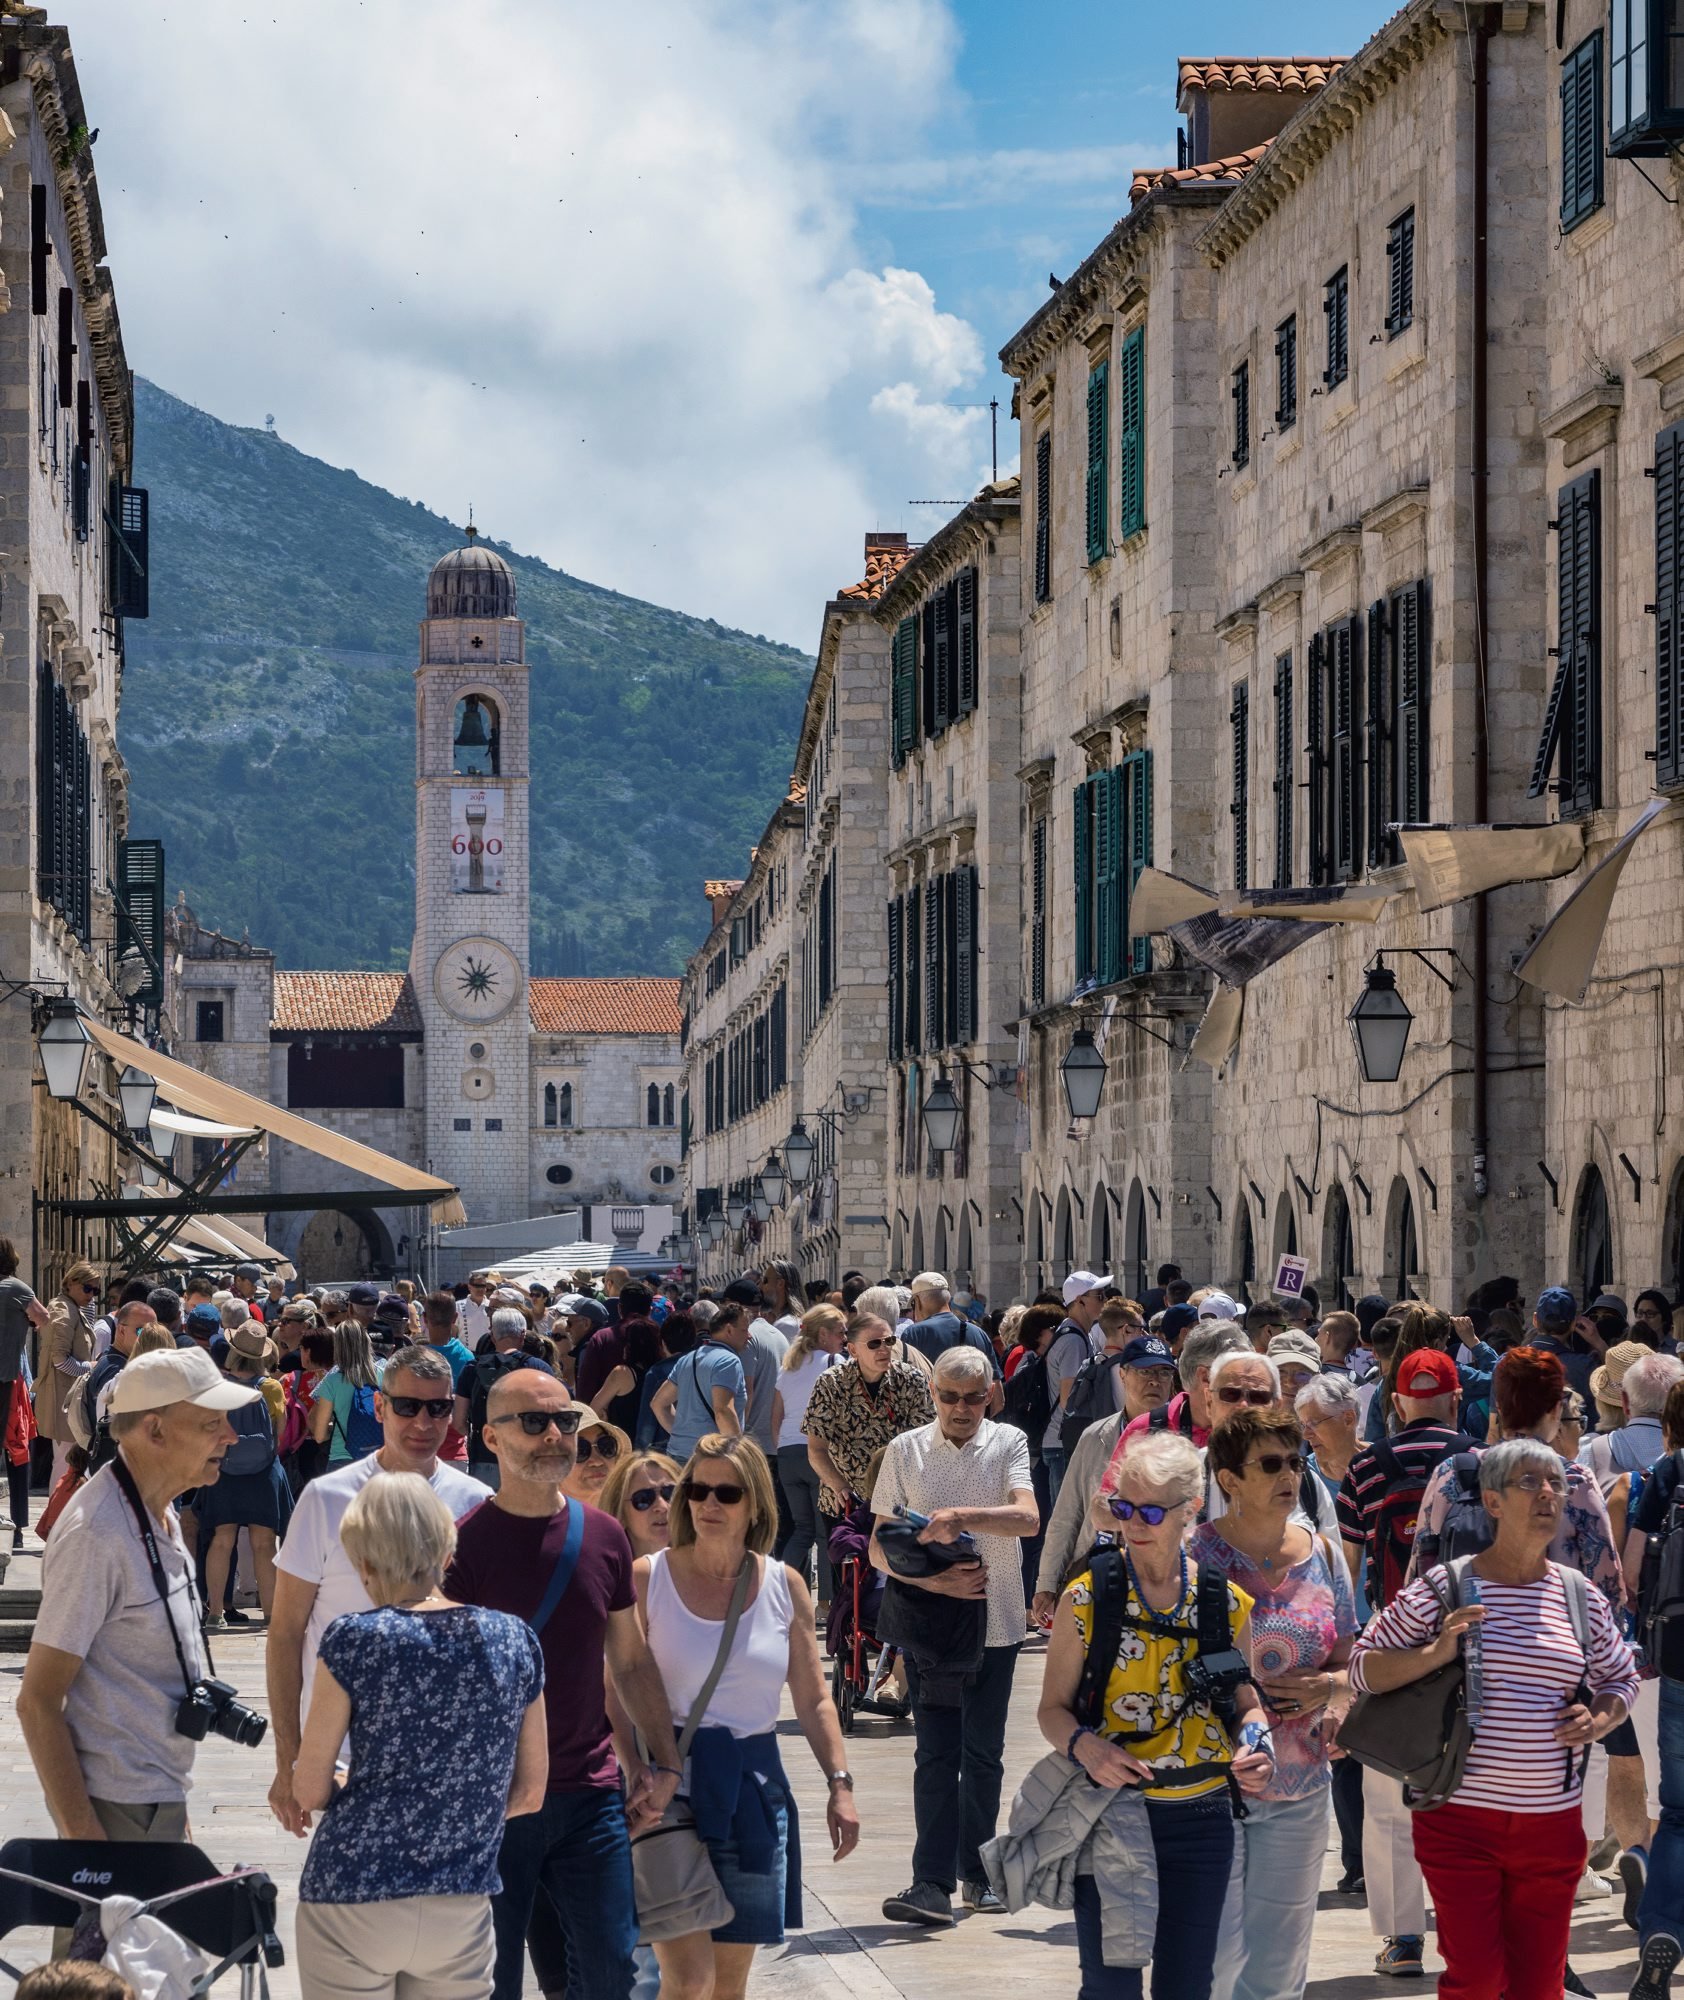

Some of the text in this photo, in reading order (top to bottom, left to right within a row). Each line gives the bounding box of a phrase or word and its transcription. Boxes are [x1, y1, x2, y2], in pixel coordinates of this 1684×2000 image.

[452, 834, 502, 855] 600
[1283, 1271, 1297, 1289] R
[146, 1532, 158, 1564] Canon
[72, 1867, 112, 1884] drive
